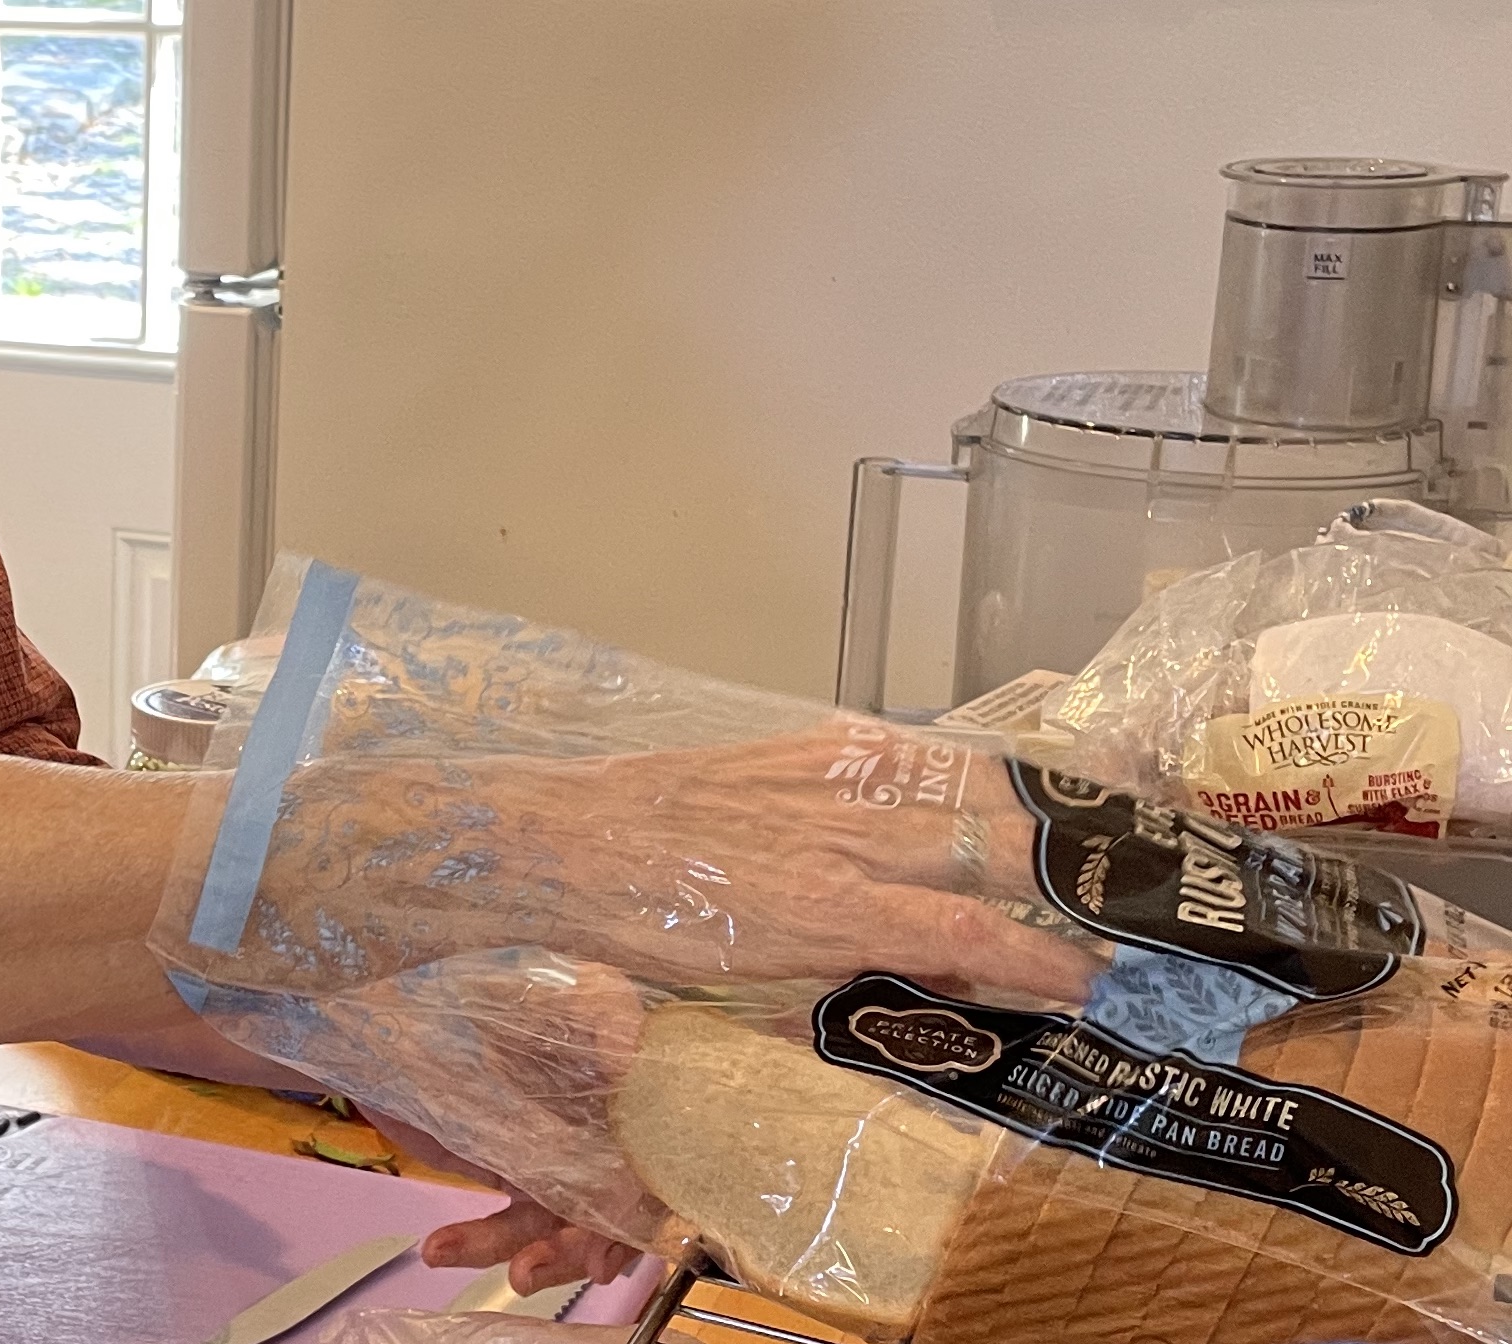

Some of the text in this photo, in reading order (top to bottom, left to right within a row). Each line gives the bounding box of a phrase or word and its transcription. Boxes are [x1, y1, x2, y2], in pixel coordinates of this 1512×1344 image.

[1314, 253, 1343, 263] MAX
[1314, 263, 1339, 275] FILL
[1254, 712, 1276, 726] MADE
[1280, 704, 1303, 716] WITH
[1341, 700, 1379, 711] GRAINS
[1242, 711, 1399, 751] WHOLESOME
[1267, 733, 1373, 765] HARVEST
[1368, 769, 1422, 787] BURSTING
[1216, 790, 1303, 813] GRAIN
[1305, 789, 1321, 805] &
[1362, 788, 1389, 802] WITH
[1391, 783, 1421, 799] FLAX
[1279, 812, 1324, 825] BREAD
[1441, 967, 1476, 998] NET
[868, 1027, 978, 1059] SELECTION
[876, 1020, 978, 1047] PRIVATE
[1106, 1060, 1207, 1109] RUSTIC
[1210, 1085, 1299, 1131] WHITE
[1007, 1064, 1080, 1108] SLICED
[1150, 1113, 1196, 1146] PAN
[1206, 1130, 1286, 1163] BREAD
